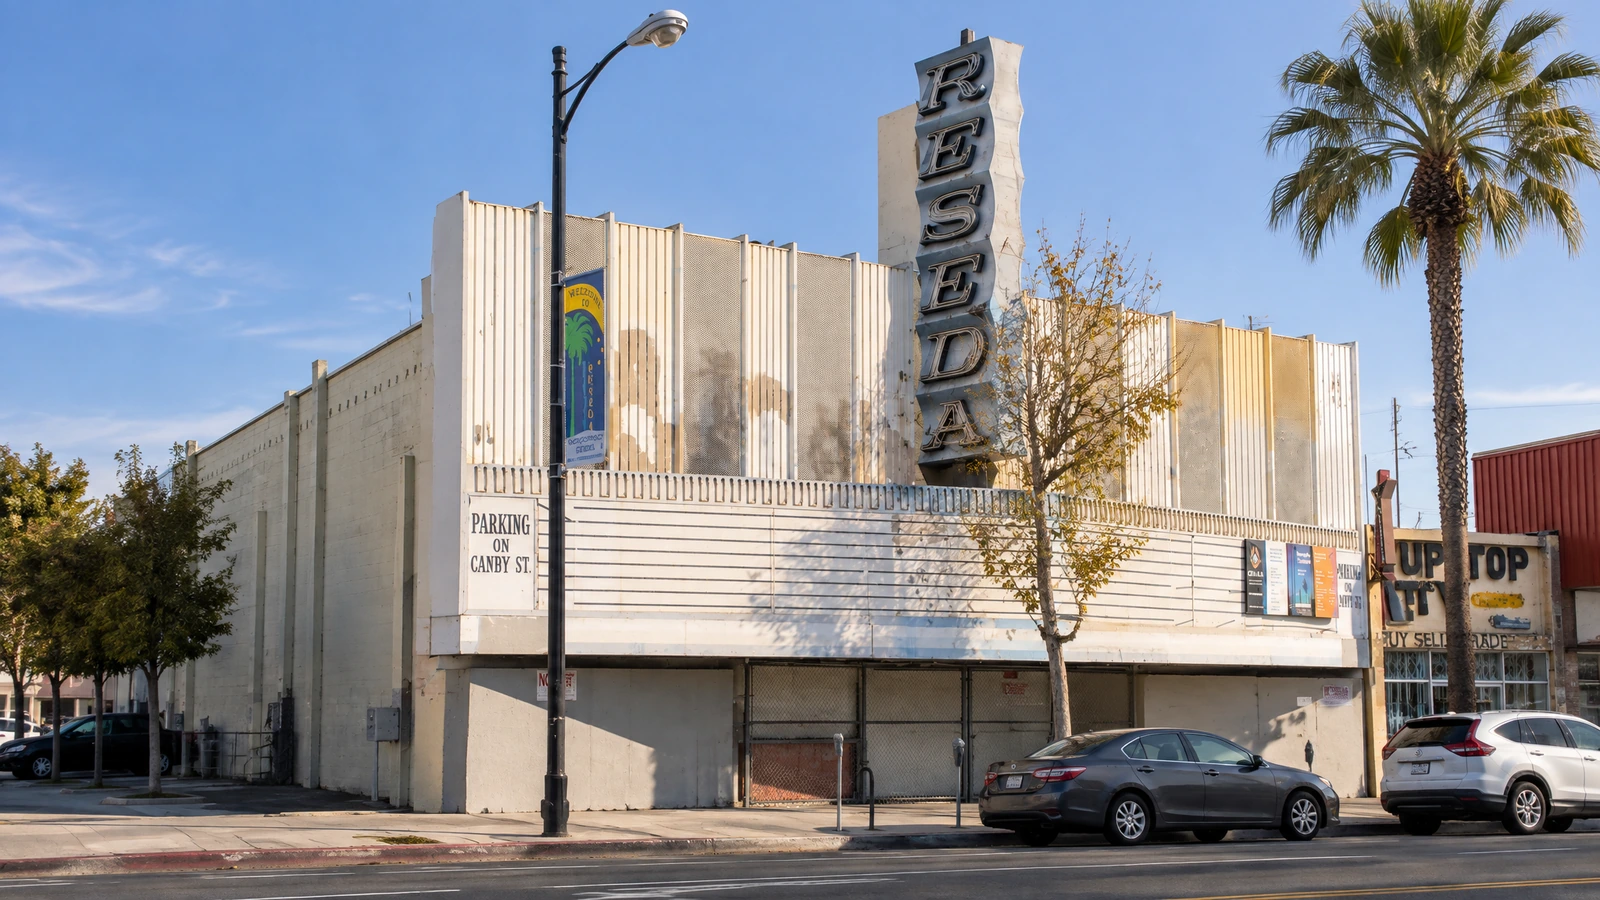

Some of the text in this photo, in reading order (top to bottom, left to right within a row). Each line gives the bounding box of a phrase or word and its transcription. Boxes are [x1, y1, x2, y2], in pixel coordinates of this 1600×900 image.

[919, 52, 987, 452] RESEDA
[471, 513, 530, 535] PARKING
[493, 538, 510, 553] ON
[470, 555, 532, 573] CANBY ST.
[1400, 542, 1444, 578] UP
[1469, 545, 1529, 581] TOP
[1472, 633, 1508, 649] RADE
